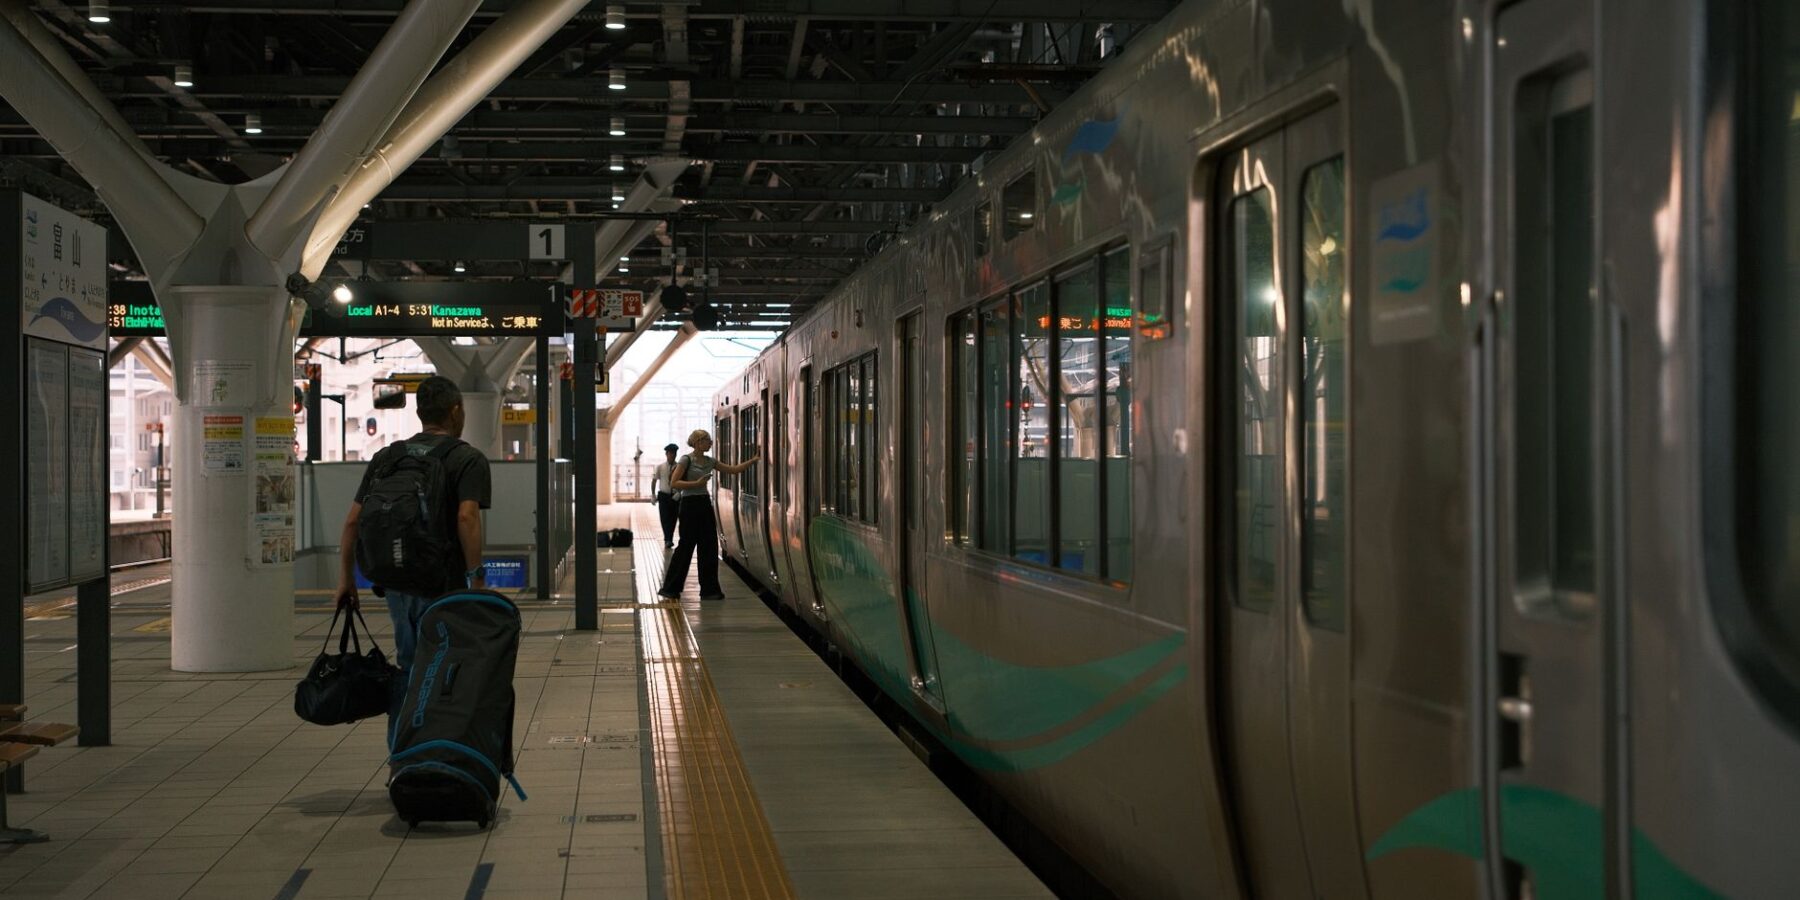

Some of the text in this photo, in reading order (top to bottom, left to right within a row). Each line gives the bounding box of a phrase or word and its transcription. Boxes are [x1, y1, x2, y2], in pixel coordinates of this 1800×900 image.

[53, 221, 81, 269] 富山
[539, 228, 552, 256] 1
[547, 284, 556, 303] 1
[347, 305, 373, 316] Local
[408, 305, 432, 316] 5:31
[432, 304, 482, 316] Kanazawa
[432, 317, 445, 328] Not
[446, 317, 453, 328] in
[411, 621, 450, 728] STARBOARD
